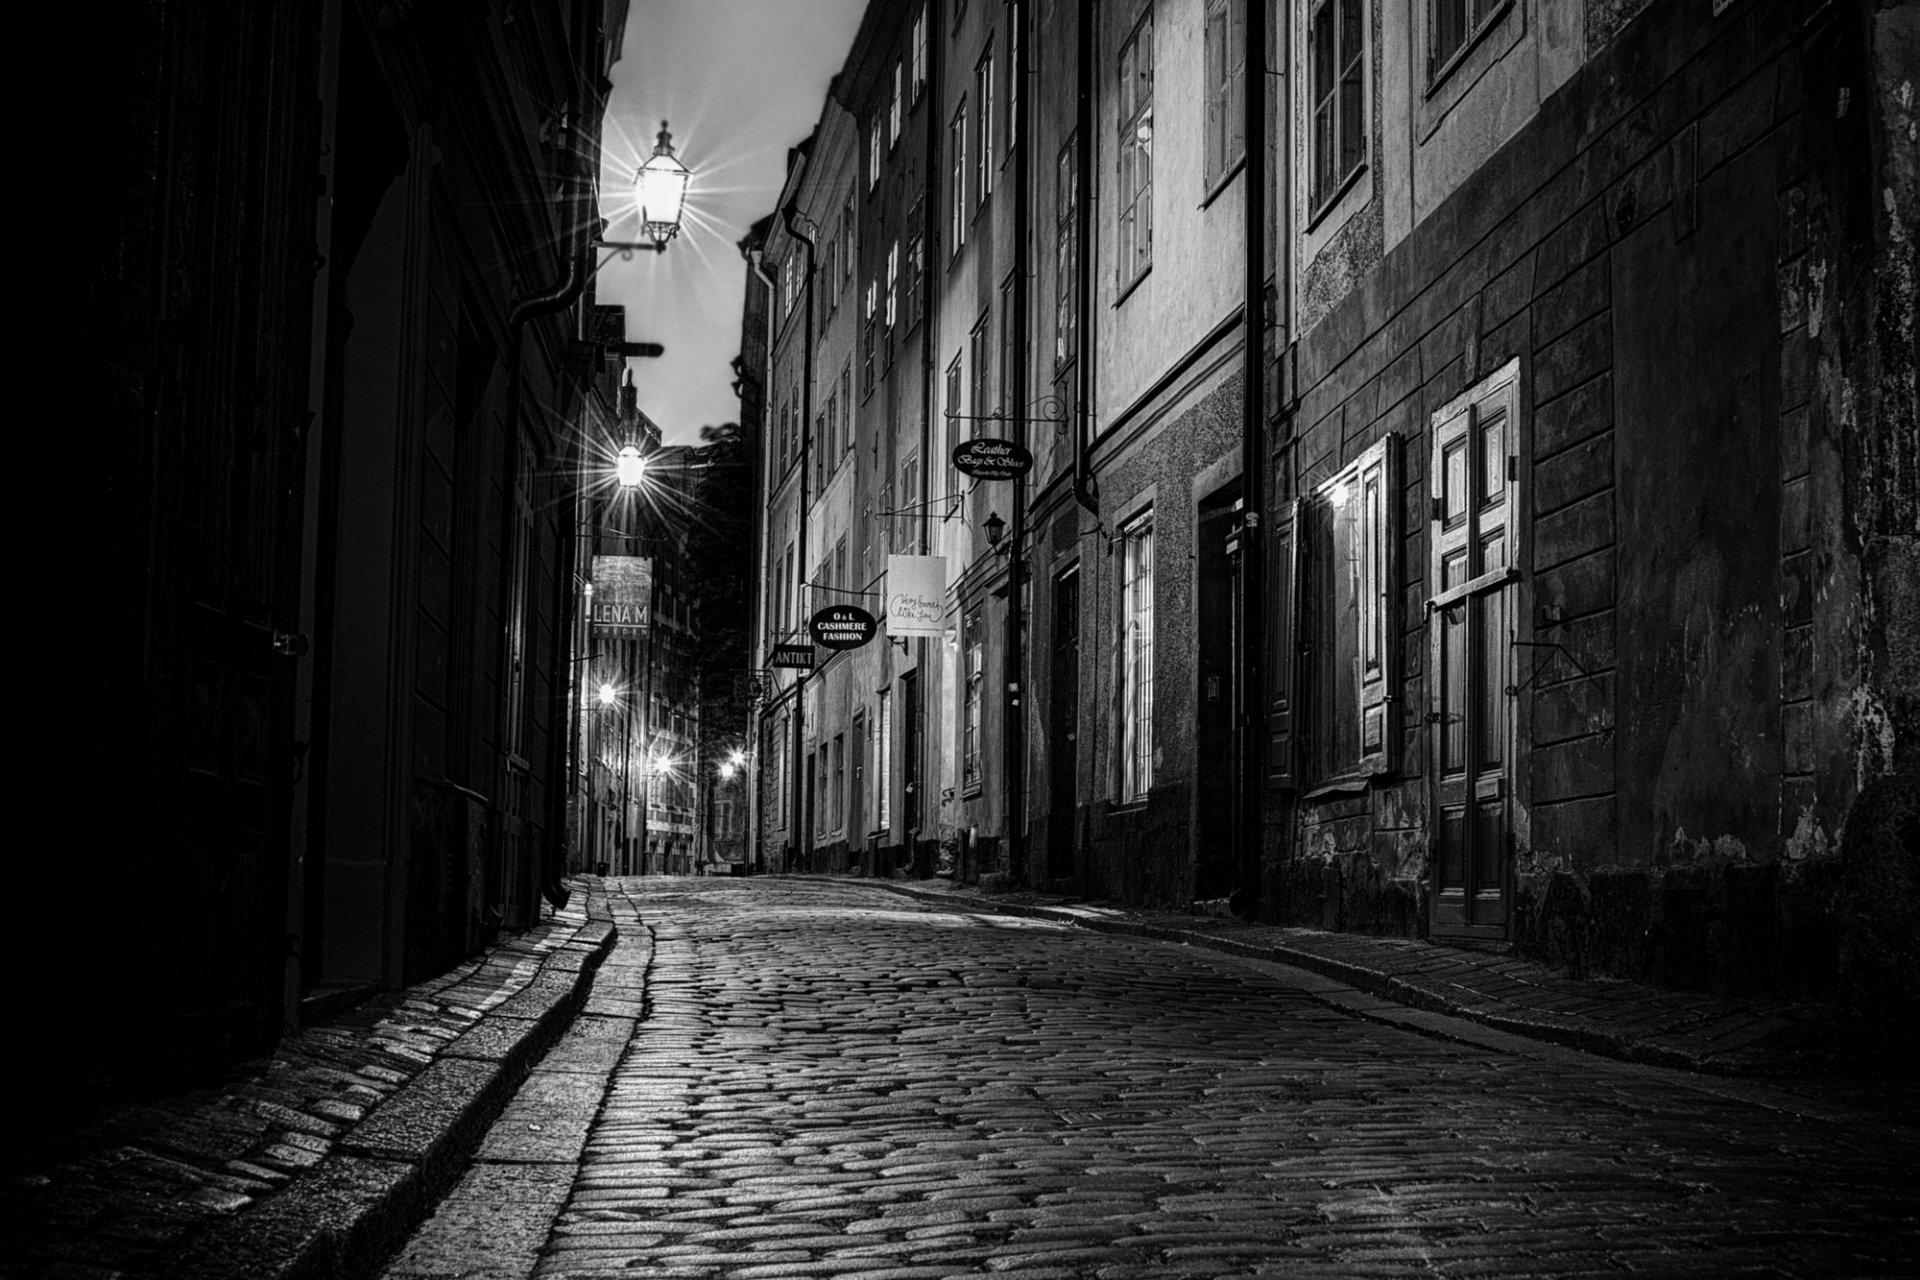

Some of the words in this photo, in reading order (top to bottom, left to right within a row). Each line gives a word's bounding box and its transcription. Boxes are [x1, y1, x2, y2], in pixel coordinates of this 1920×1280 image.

[970, 441, 1012, 455] Leather
[983, 456, 996, 466] &
[593, 604, 631, 623] LENA
[635, 606, 648, 624] M
[833, 612, 841, 621] O
[848, 612, 855, 621] L
[593, 627, 647, 635] SWEDEN
[817, 622, 867, 631] CASHMERE
[823, 632, 863, 641] FASHION
[775, 651, 814, 665] ANTIKT
